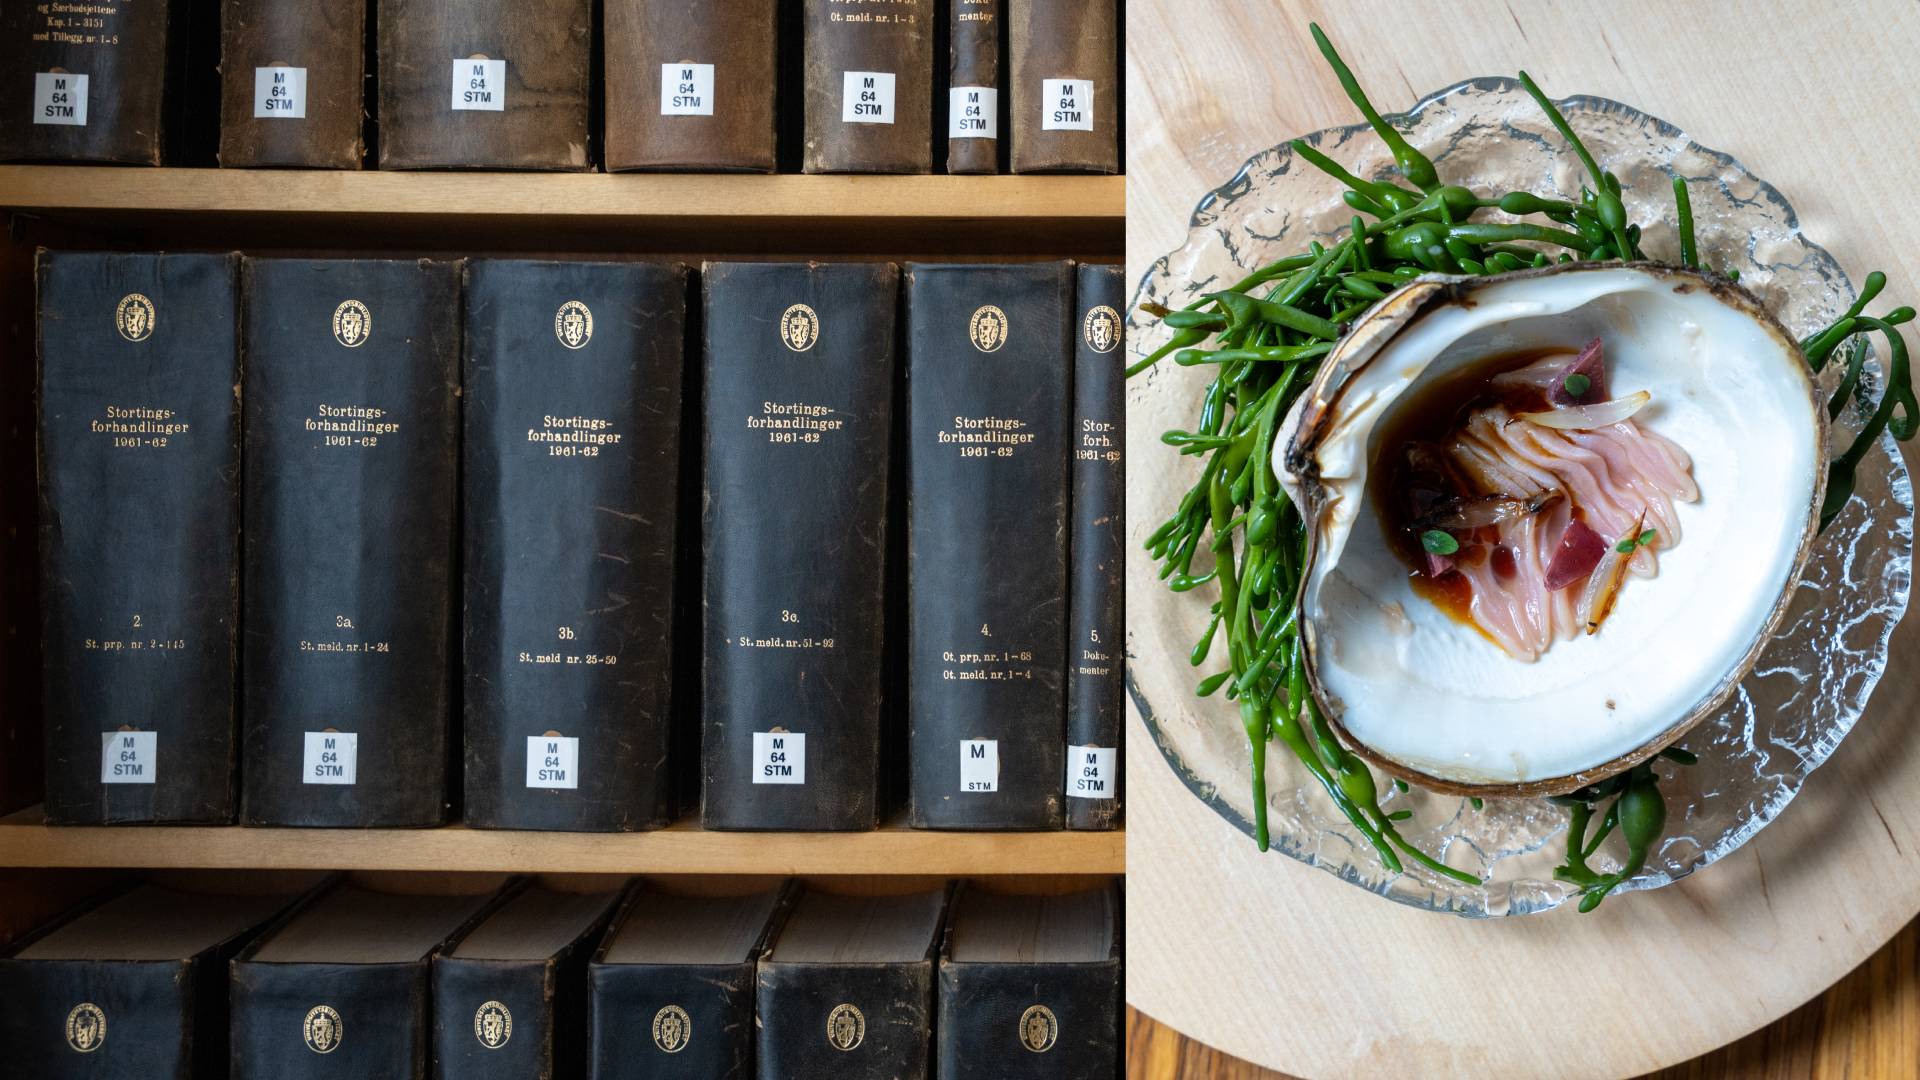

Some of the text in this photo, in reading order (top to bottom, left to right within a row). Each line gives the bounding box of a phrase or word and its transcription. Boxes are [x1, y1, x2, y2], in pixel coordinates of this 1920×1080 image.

[37, 4, 49, 15] og
[830, 12, 843, 22] Ot.
[875, 14, 890, 23] nr.
[473, 65, 484, 76] M
[682, 69, 693, 81] M
[55, 78, 66, 90] M
[274, 72, 285, 84] M
[470, 78, 486, 89] 64
[863, 77, 875, 89] M
[271, 85, 286, 97] 64
[679, 83, 695, 94] 64
[1062, 84, 1073, 96] M
[52, 92, 68, 104] 64
[464, 91, 492, 103] STM
[673, 96, 701, 107] STM
[860, 90, 876, 102] 64
[968, 92, 979, 103] M
[265, 98, 292, 111] STM
[854, 103, 882, 116] STM
[1060, 98, 1076, 109] 64
[44, 104, 74, 118] STM
[966, 105, 981, 117] 64
[1054, 111, 1081, 123] STM
[959, 118, 987, 130] STM
[108, 406, 175, 419] Stortings-
[319, 405, 386, 418] Stortings-
[764, 402, 834, 416] Stortings-
[92, 419, 188, 434] forhandlinger
[306, 418, 399, 433] forhandlinger
[544, 415, 612, 430] Stortings-
[748, 415, 842, 431] forhandlinger
[956, 417, 1026, 429] Stortings-
[1083, 419, 1115, 433] Stor-
[116, 438, 166, 447] 1961-62
[326, 436, 377, 446] 1961-62
[528, 429, 621, 444] forhandlinger
[770, 433, 819, 442] 1961-62
[939, 429, 1034, 444] forhandlinger
[1083, 434, 1113, 447] forh.
[550, 446, 598, 456] 1961-62
[961, 447, 1012, 456] 1961-62
[134, 615, 142, 627] 2.
[337, 616, 354, 628] 3a.
[782, 610, 799, 622] 3c.
[559, 627, 576, 640] 3b.
[981, 624, 991, 636] 4.
[740, 637, 754, 647] St.
[786, 639, 802, 648] nr.
[1091, 630, 1100, 643] 5.
[85, 639, 99, 649] St.
[104, 640, 125, 651] prp.
[301, 640, 315, 651] St.
[346, 644, 362, 652] nr.
[520, 652, 533, 663] St.
[567, 656, 582, 664] nr.
[943, 651, 957, 662] Ot.
[959, 653, 982, 663] prp.
[984, 653, 1000, 662] nr.
[1082, 650, 1109, 660] Doku-
[943, 670, 957, 680] Ot.
[990, 671, 1006, 680] nr.
[123, 737, 135, 748] M
[324, 738, 336, 749] M
[547, 743, 558, 754] M
[773, 738, 784, 750] M
[120, 751, 136, 762] 64
[770, 751, 786, 763] 64
[970, 743, 985, 759] M
[321, 752, 337, 763] 64
[545, 757, 559, 767] 64
[1086, 753, 1097, 765] M
[114, 764, 143, 775] STM
[315, 765, 343, 776] STM
[538, 769, 565, 781] STM
[764, 764, 792, 777] STM
[1083, 766, 1099, 778] 64
[968, 782, 991, 791] STM
[1077, 779, 1104, 792] STM
